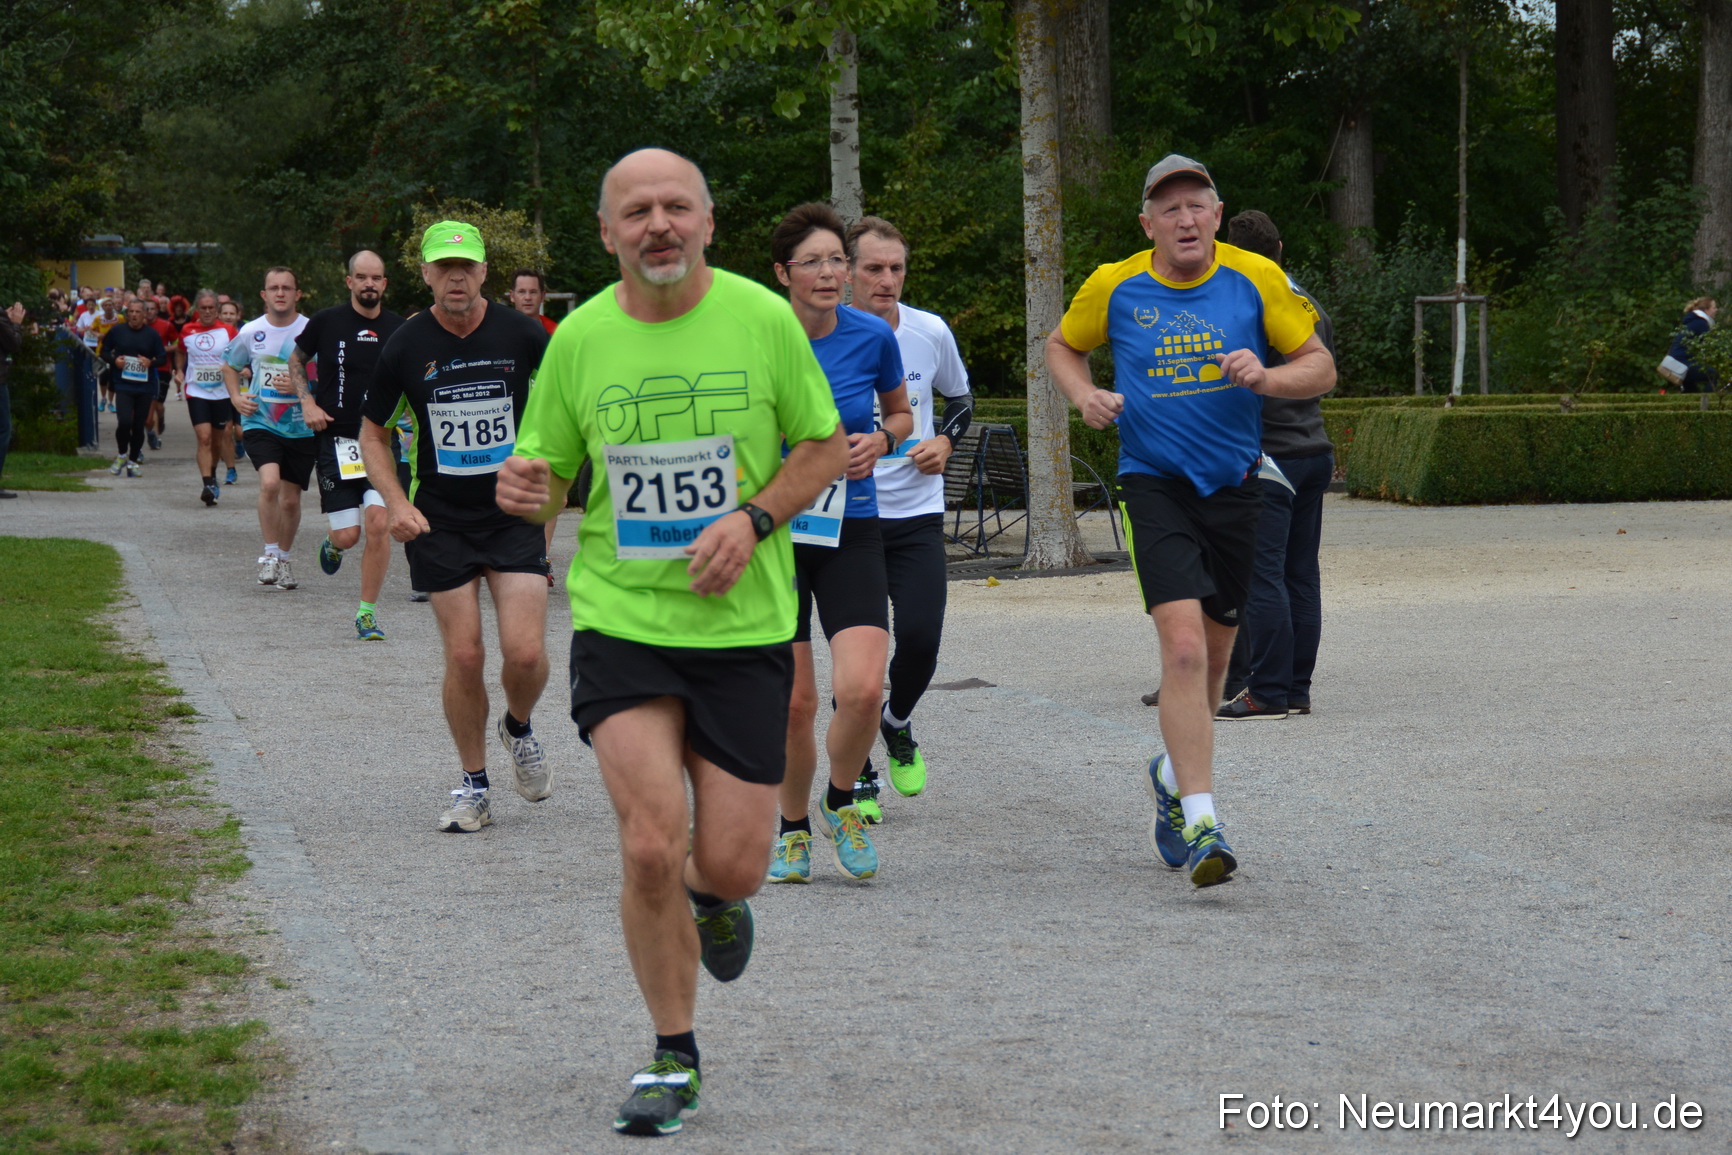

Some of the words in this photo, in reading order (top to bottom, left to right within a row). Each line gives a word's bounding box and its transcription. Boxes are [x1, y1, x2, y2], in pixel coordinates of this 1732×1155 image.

[196, 371, 222, 382] 2055
[431, 410, 458, 418] PARTL
[460, 407, 500, 417] Neumarkt
[440, 416, 508, 447] 2185
[461, 454, 492, 465] Klaus
[608, 454, 648, 466] PARTL
[650, 451, 712, 465] Neumarkt
[623, 466, 726, 513] 2153
